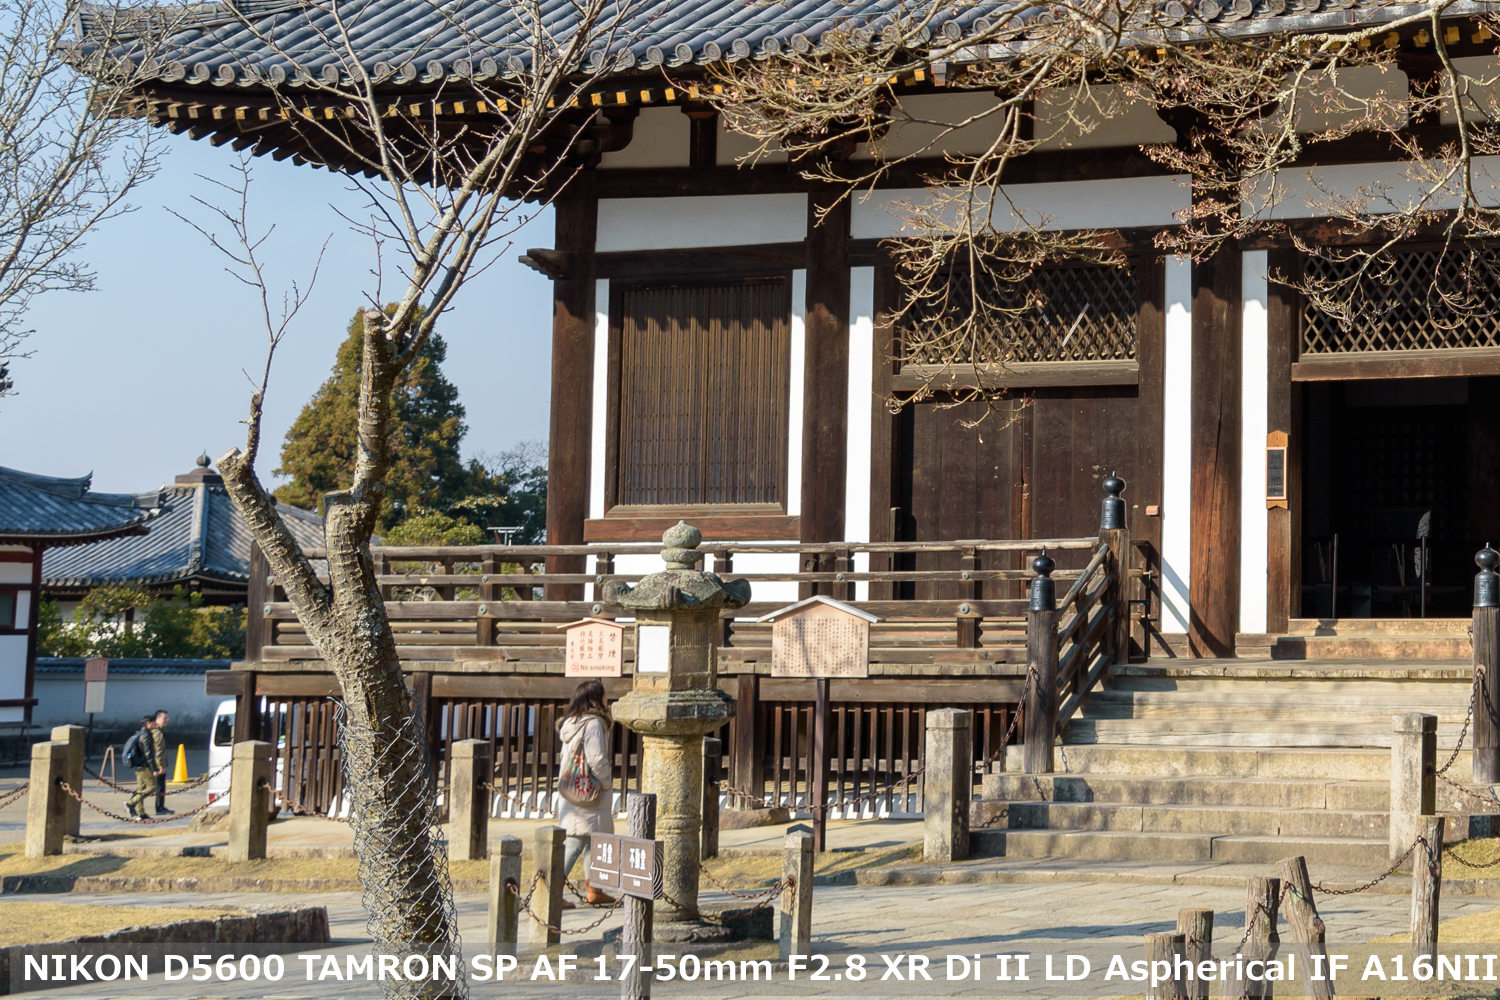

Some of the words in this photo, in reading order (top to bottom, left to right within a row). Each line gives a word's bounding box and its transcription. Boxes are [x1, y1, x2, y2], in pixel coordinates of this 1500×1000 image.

[608, 632, 616, 658] 禁煙
[590, 664, 615, 672] smoking
[597, 843, 612, 864] 二月堂
